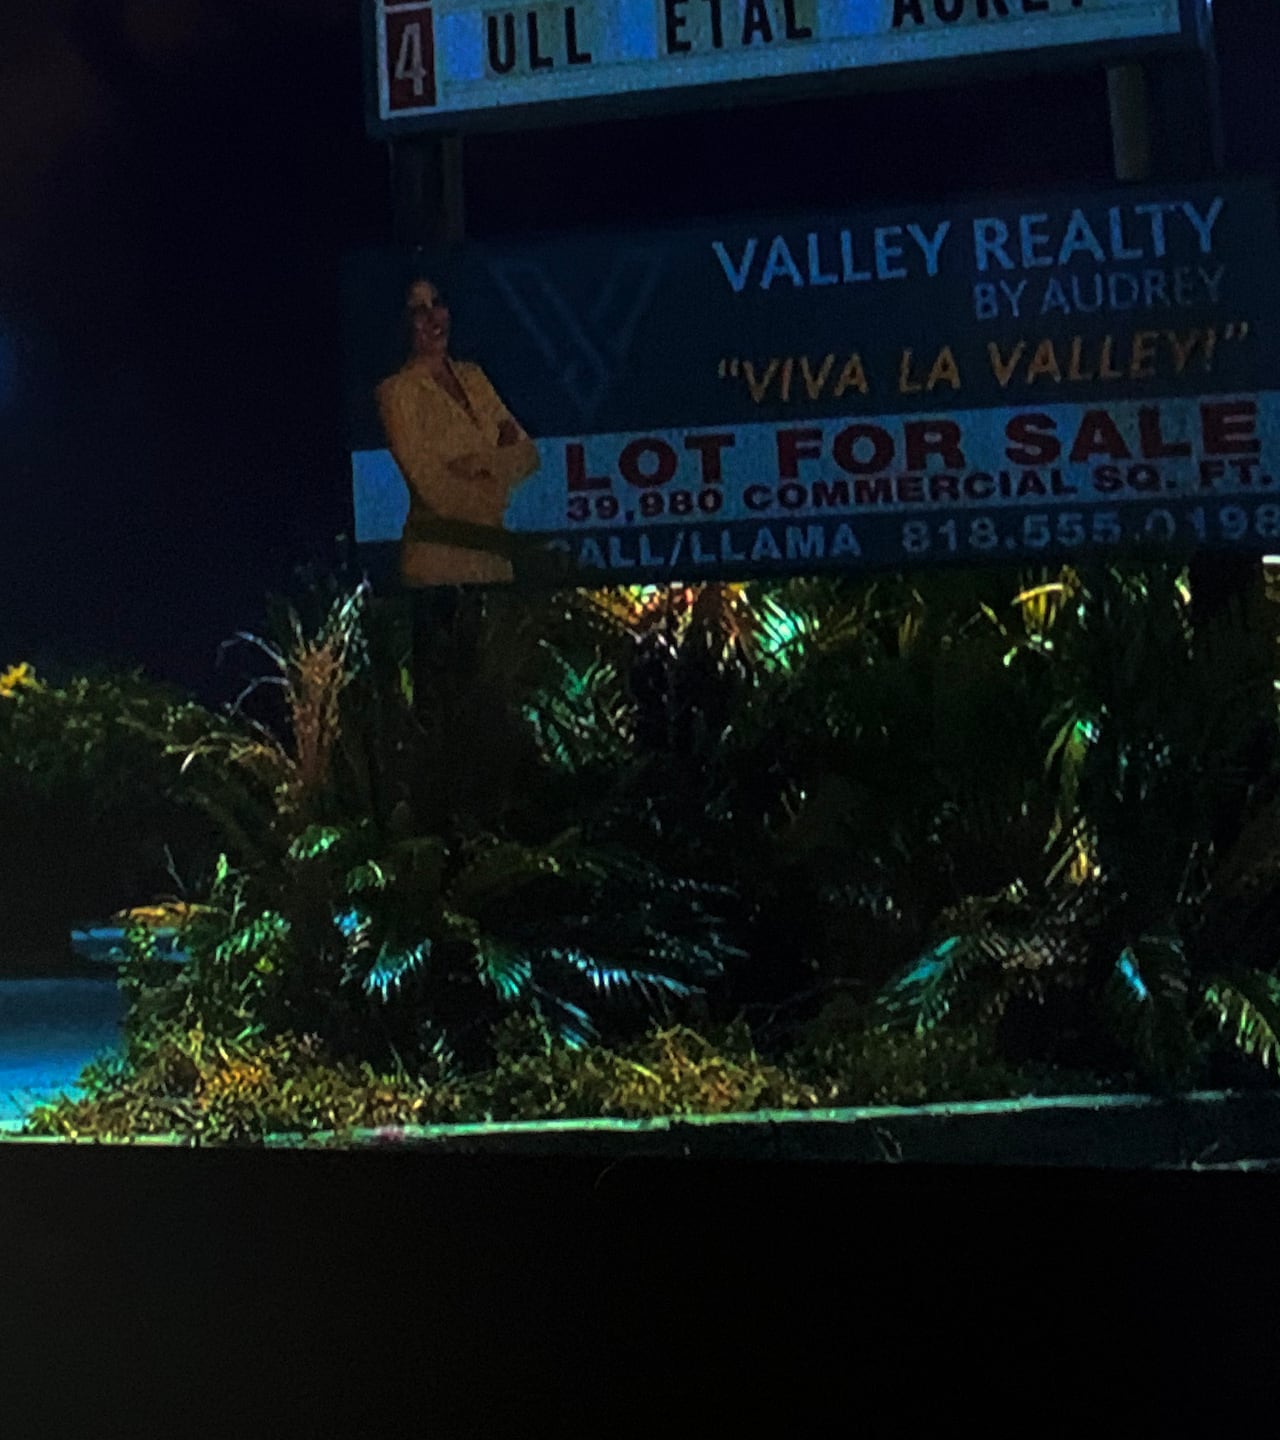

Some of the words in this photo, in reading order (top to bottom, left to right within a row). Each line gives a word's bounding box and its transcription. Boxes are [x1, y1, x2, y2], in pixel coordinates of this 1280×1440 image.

[711, 219, 951, 295] VALLEY
[973, 194, 1227, 271] REALTY
[973, 279, 1029, 321] BY
[1040, 263, 1228, 315] AUDREY
[898, 344, 963, 396] LA
[564, 433, 735, 494] LOT
[776, 419, 966, 481] FOR
[1004, 398, 1261, 467] SALE
[565, 487, 723, 523] 39,980
[742, 467, 1078, 512] COMMERCIAL
[1093, 461, 1177, 495] SQ.
[1200, 453, 1275, 489] FT.
